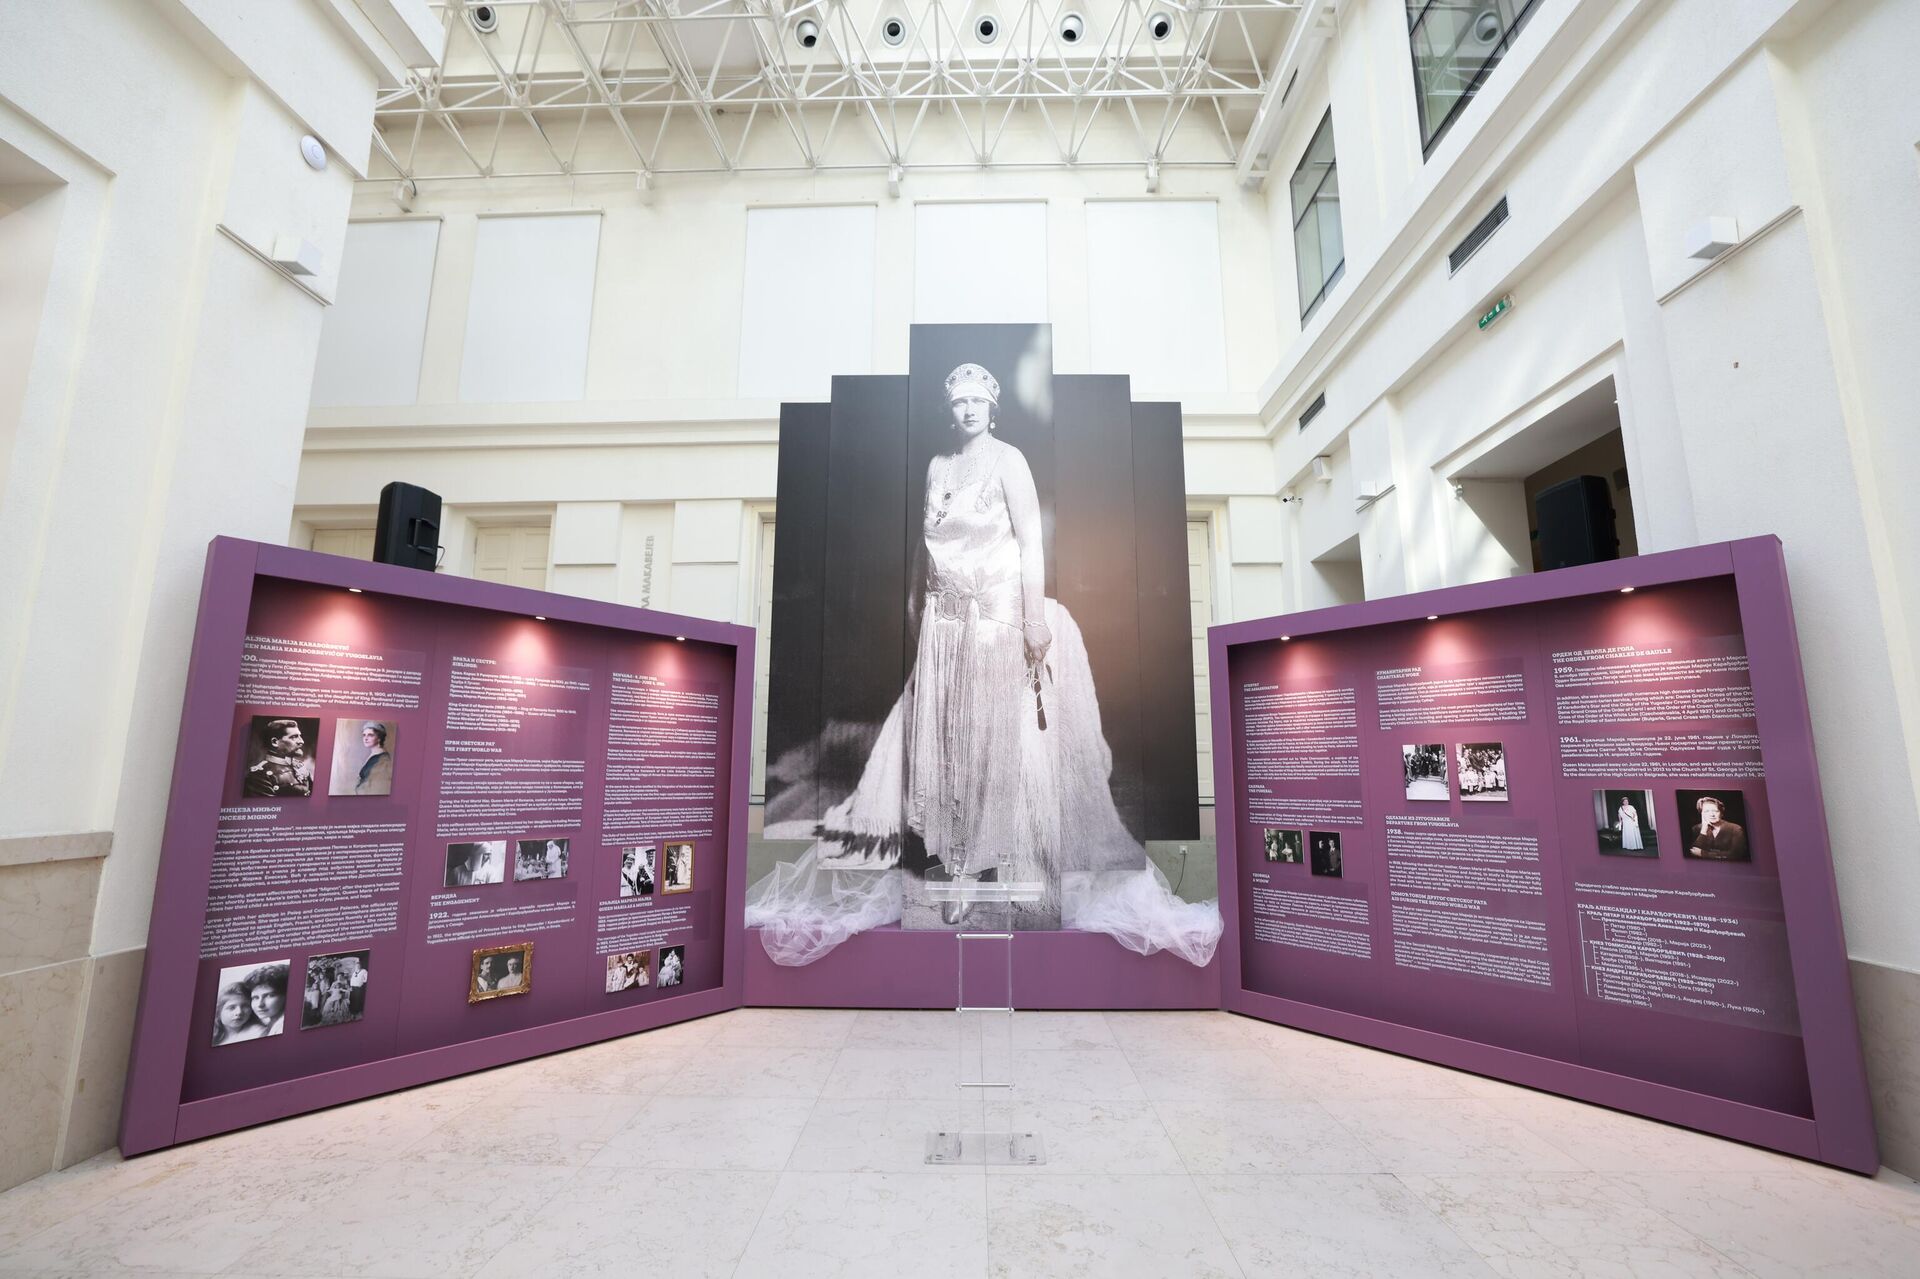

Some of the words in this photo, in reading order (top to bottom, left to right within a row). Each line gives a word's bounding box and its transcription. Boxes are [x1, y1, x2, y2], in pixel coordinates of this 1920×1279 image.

[1604, 651, 1634, 659] CHARLES
[1645, 648, 1672, 656] GAULLE
[442, 898, 480, 906] ENGAGEMENT
